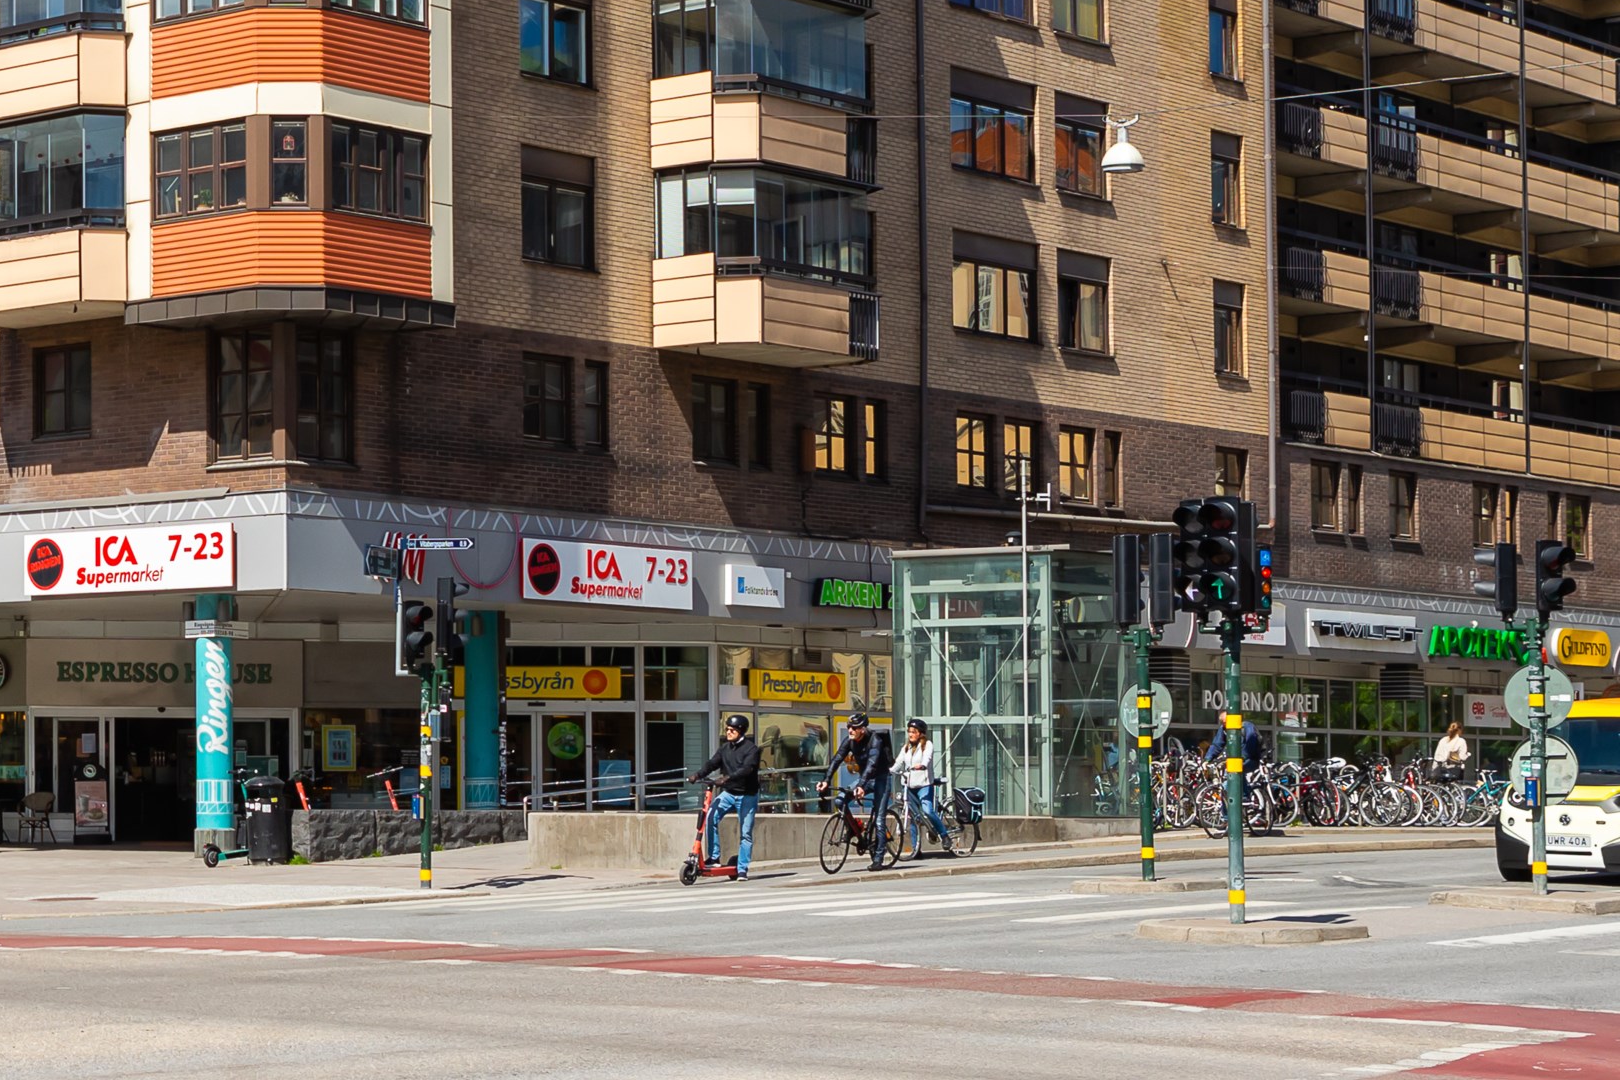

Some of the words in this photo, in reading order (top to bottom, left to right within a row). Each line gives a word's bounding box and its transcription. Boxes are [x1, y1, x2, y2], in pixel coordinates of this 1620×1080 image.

[95, 535, 138, 567] ICA
[168, 531, 225, 562] 7-23
[76, 564, 165, 588] Supermarket
[587, 548, 623, 582] ICA
[646, 556, 689, 586] 7-23
[570, 576, 644, 601] Supermarket
[820, 579, 883, 609] ARKEN
[1322, 622, 1423, 642] TWILFIT
[1428, 625, 1511, 659] APOTEK
[56, 661, 180, 683] ESPRESSO
[505, 671, 574, 695] ssbyrån
[762, 672, 823, 698] Pressbyrån
[1203, 689, 1261, 711] PORN
[1278, 693, 1320, 713] PYRET
[1568, 836, 1587, 846] 40A
